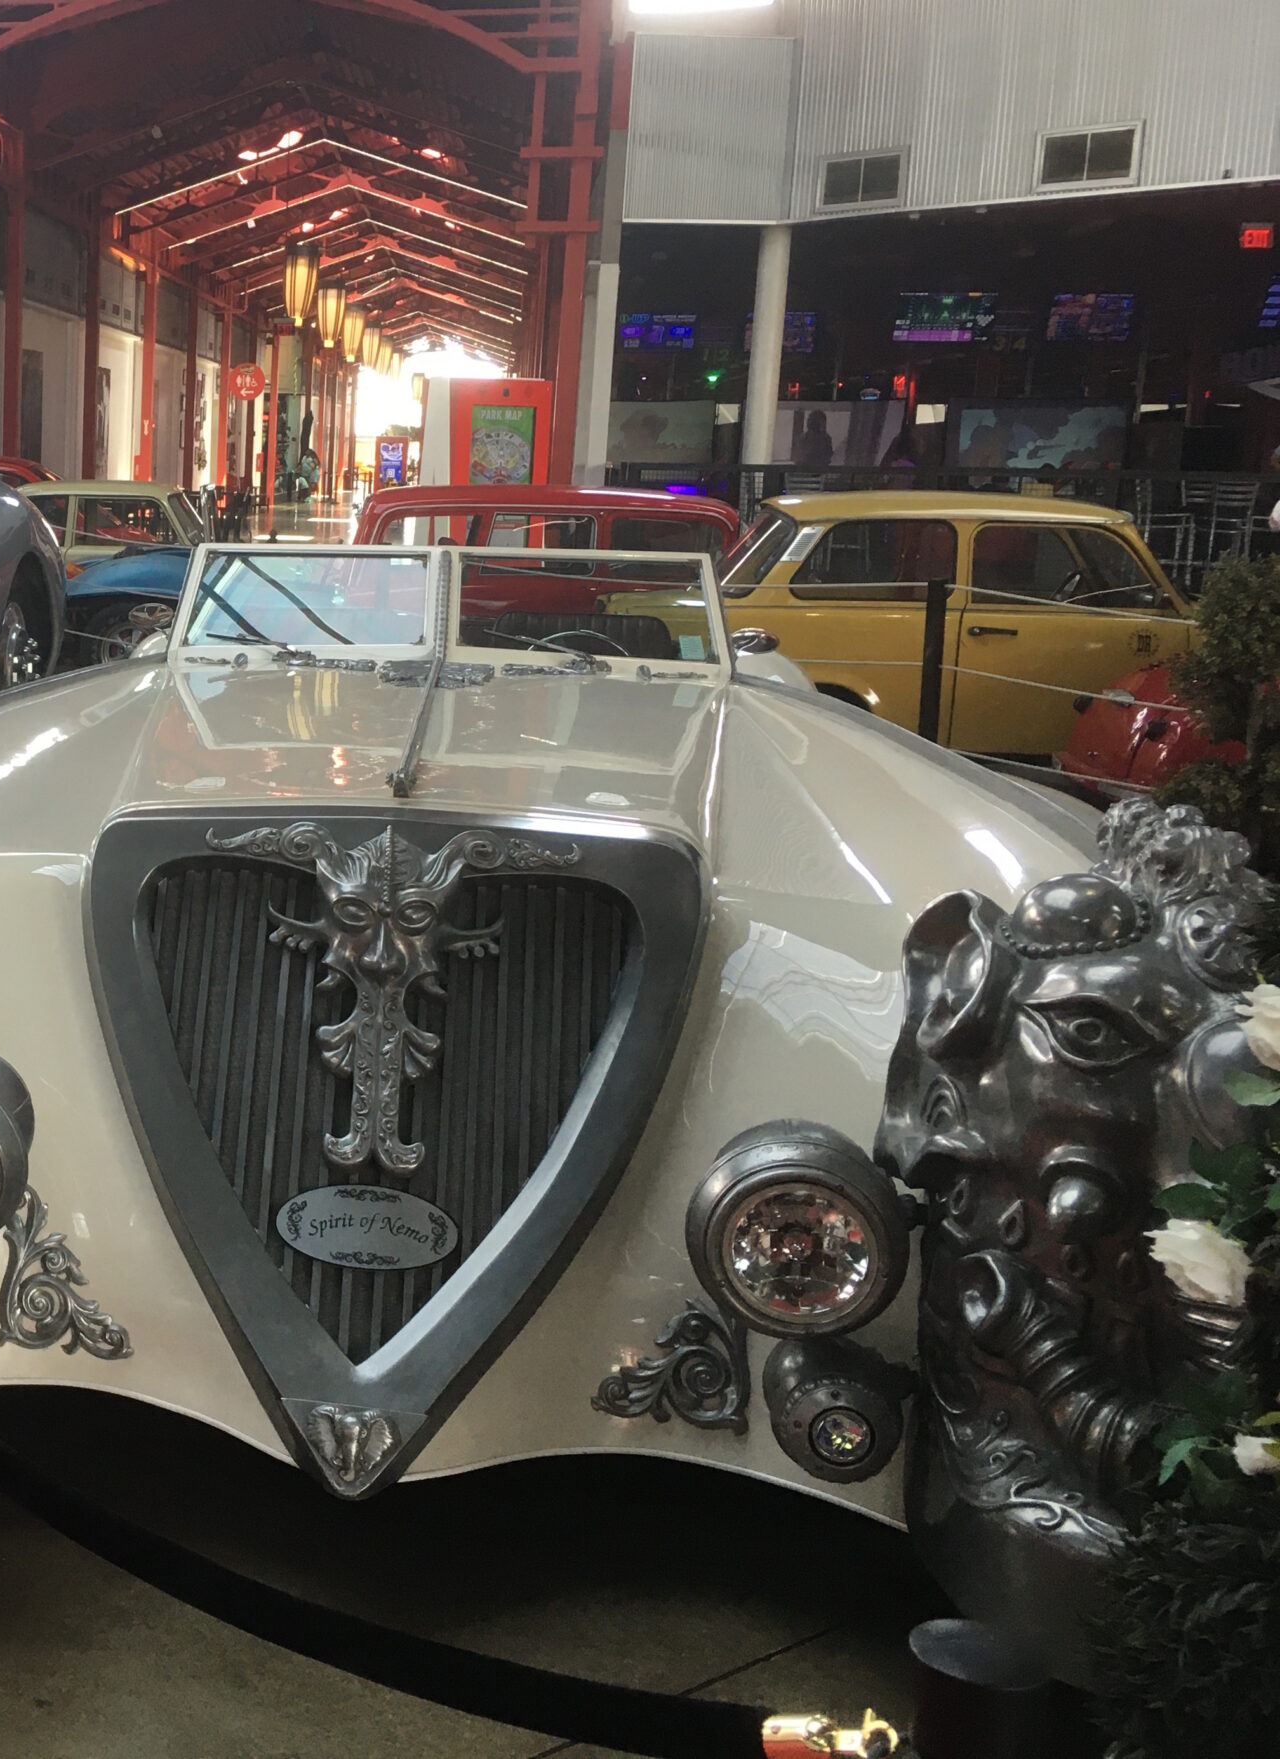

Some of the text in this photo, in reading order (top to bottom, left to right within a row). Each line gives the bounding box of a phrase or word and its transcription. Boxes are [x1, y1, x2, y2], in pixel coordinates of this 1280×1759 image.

[1244, 229, 1270, 248] EXIT
[480, 410, 522, 421] PARK MAP
[308, 1212, 429, 1244] Spirit of Nemo
